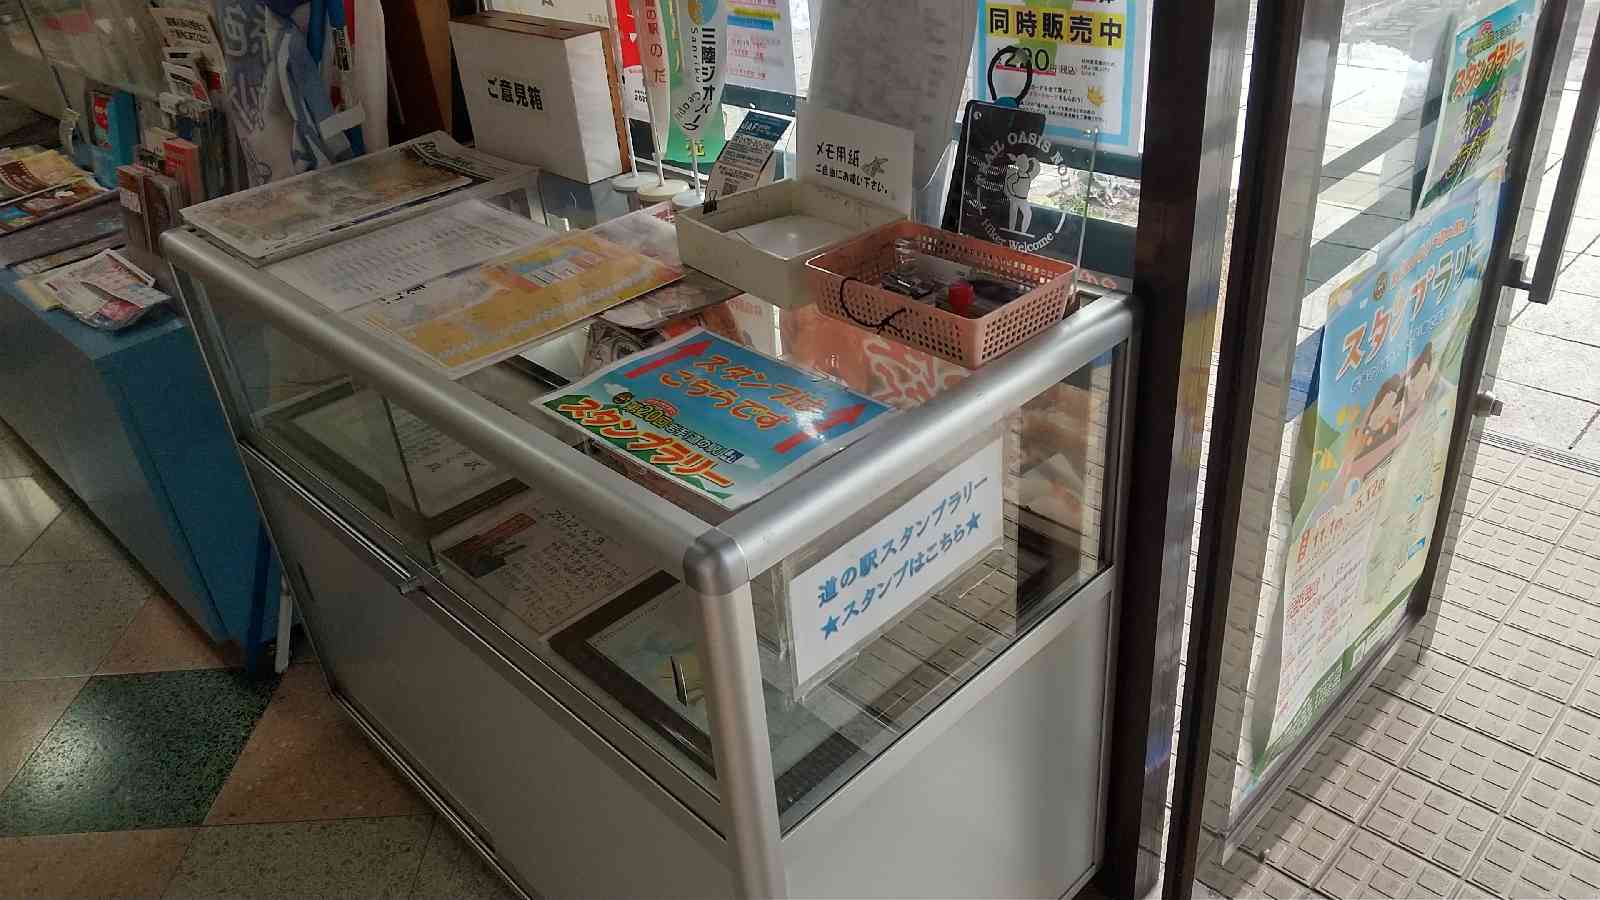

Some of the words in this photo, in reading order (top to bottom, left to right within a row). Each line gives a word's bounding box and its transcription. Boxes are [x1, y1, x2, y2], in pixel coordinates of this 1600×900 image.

[989, 7, 1122, 46] 同時販売中
[487, 77, 544, 111] ご意見箱
[682, 27, 715, 130] 三陸ジオパーク
[816, 142, 861, 168] メモ用紙
[1007, 130, 1052, 153] OASIS
[1007, 231, 1055, 252] Welcome
[659, 368, 791, 431] こちらです
[558, 397, 735, 489] スタンプラリー
[817, 476, 988, 608] 道の駅スタンプラリー
